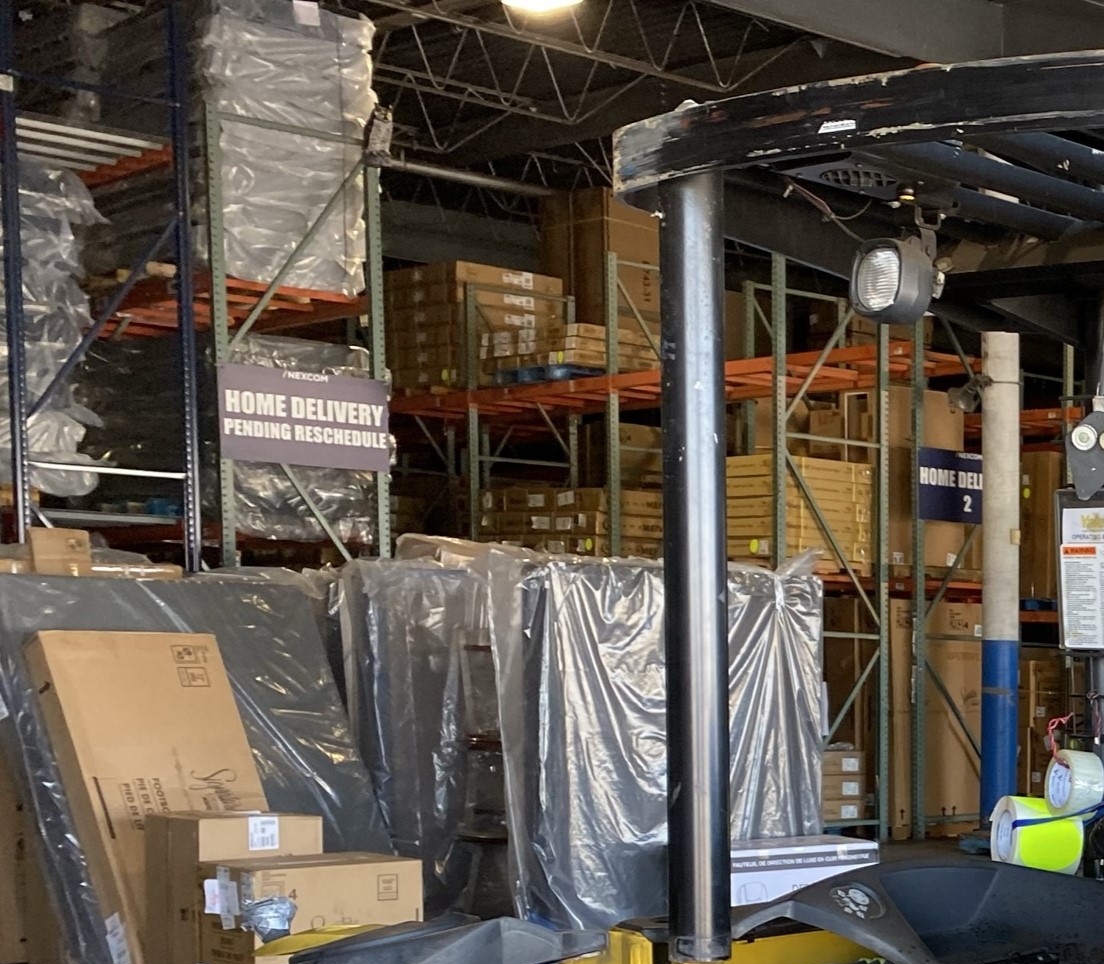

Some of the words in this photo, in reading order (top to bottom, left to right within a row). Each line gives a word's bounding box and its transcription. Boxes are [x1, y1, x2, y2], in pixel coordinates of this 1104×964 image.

[224, 389, 288, 418] HOME
[291, 396, 384, 427] DELIVERY
[223, 417, 292, 441] PENDING
[294, 424, 388, 449] RESCHEDULE
[919, 466, 957, 488] HOME
[963, 494, 973, 513] 2
[122, 783, 136, 803] PIED
